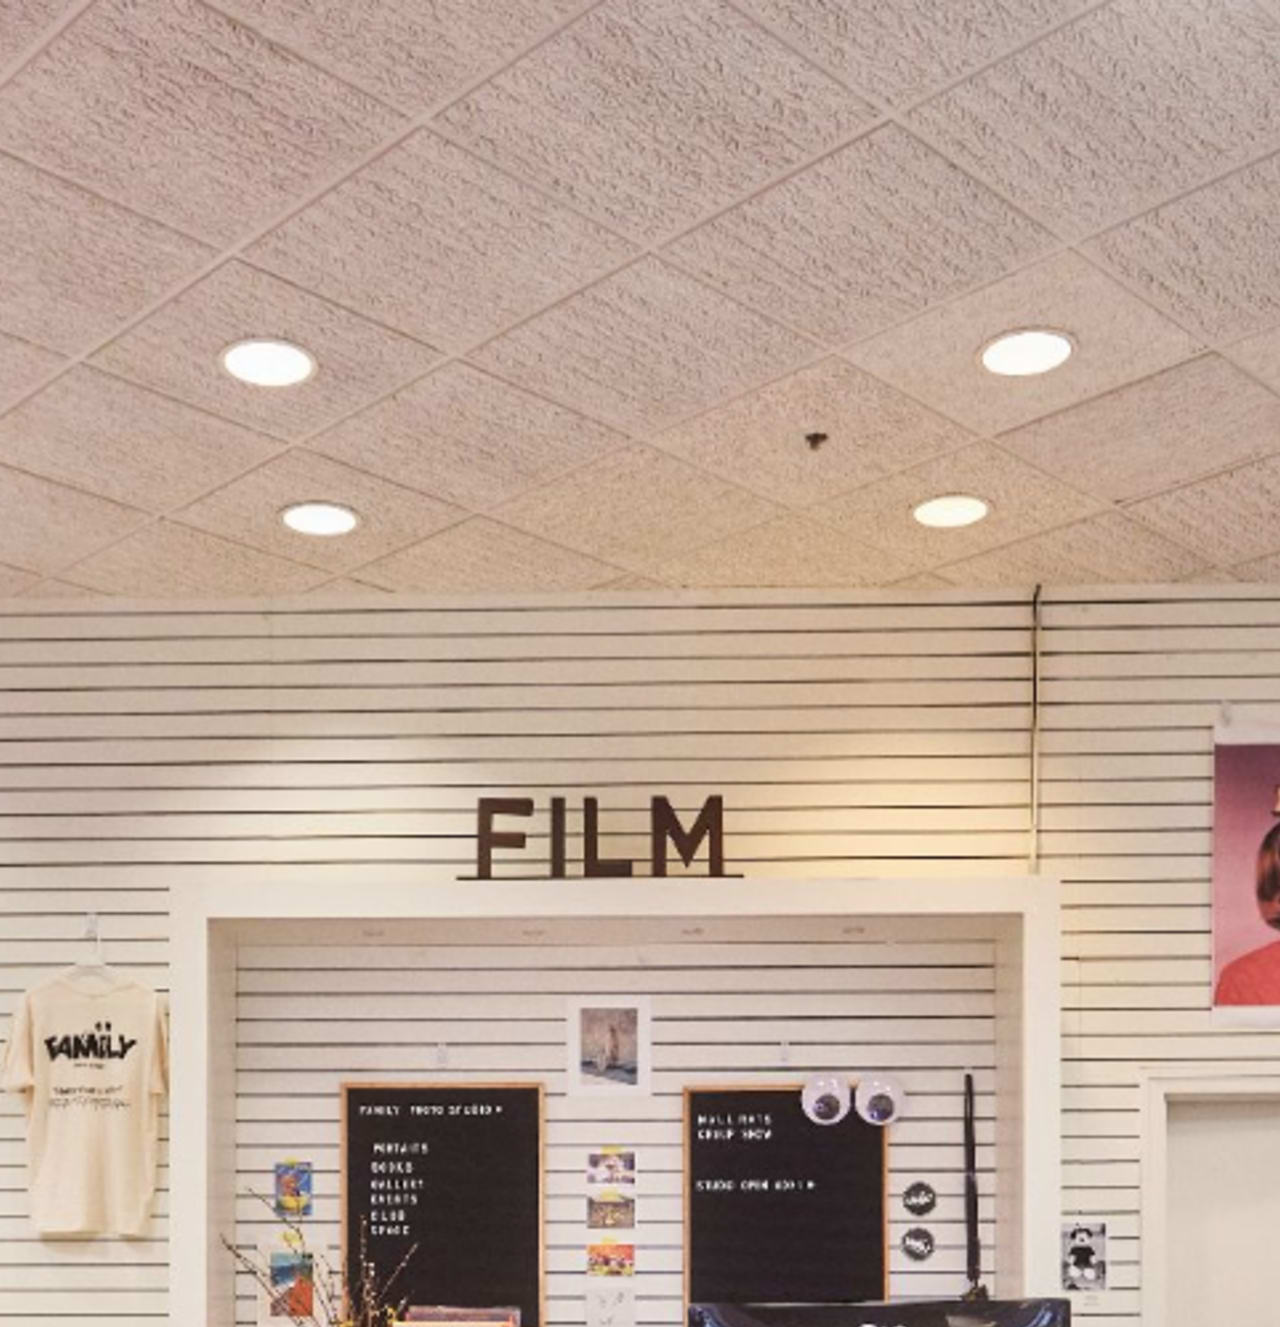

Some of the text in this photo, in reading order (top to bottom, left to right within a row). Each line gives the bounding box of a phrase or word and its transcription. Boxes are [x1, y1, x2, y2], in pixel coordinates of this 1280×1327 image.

[477, 795, 723, 877] FILM
[359, 1105, 400, 1115] FAMILY
[410, 1105, 444, 1116] PHOTO
[371, 1161, 413, 1173] BOOKS
[371, 1194, 418, 1205] EVENTS
[371, 1209, 406, 1221] CLUB
[371, 1225, 410, 1236] SPACE
